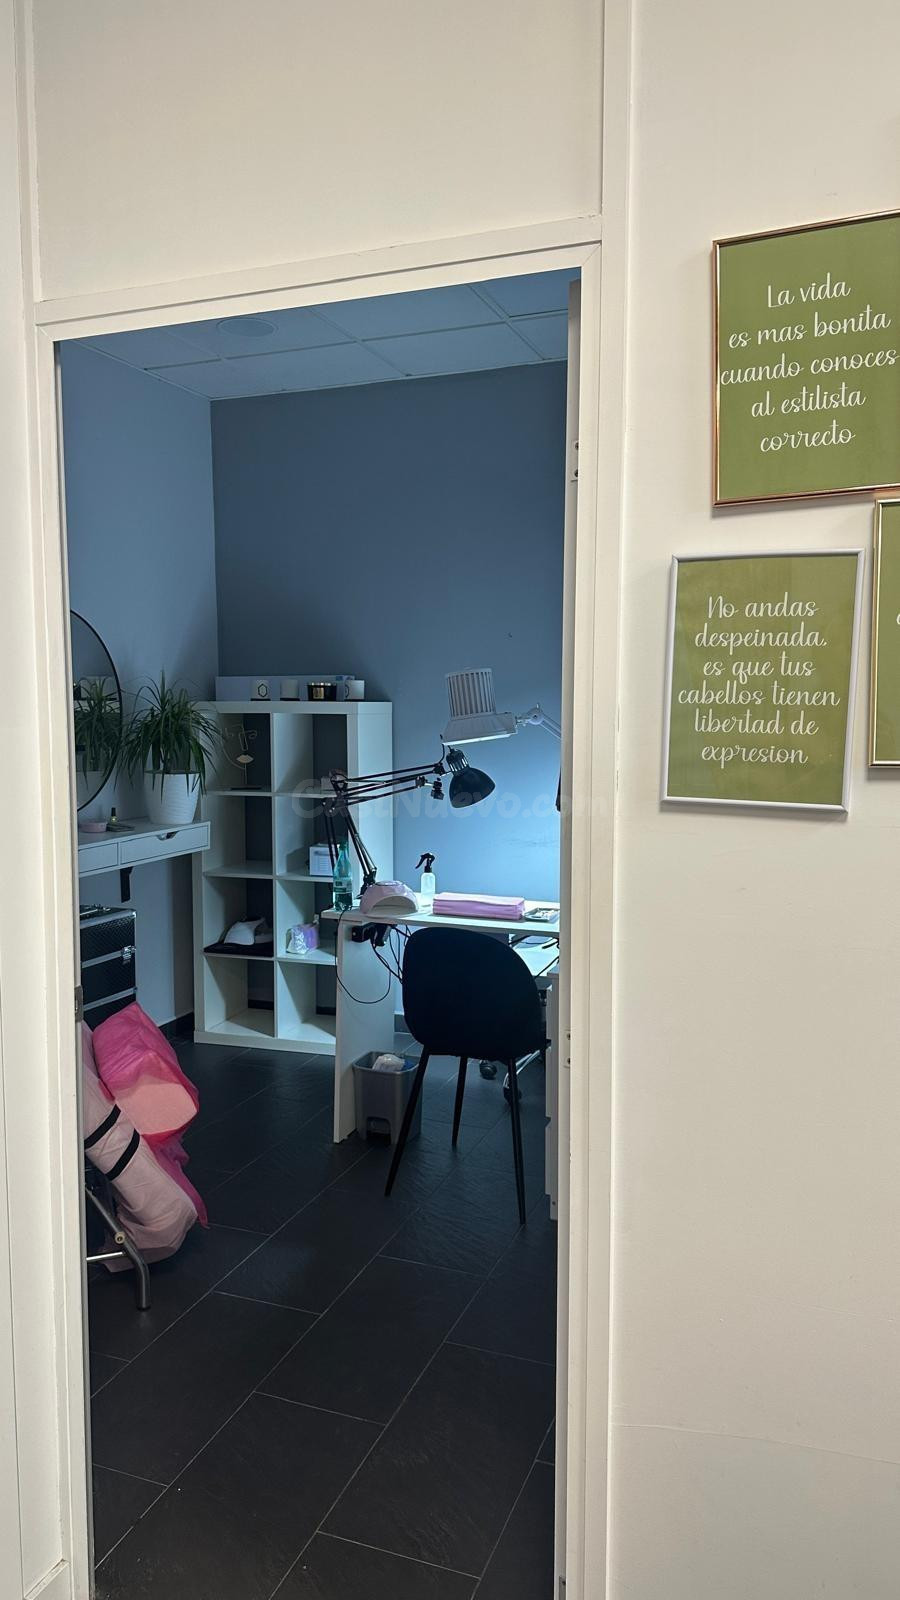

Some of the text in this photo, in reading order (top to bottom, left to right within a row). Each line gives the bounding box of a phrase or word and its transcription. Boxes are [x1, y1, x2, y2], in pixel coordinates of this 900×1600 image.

[767, 272, 852, 308] La vida
[728, 304, 892, 349] es mas bonita
[720, 349, 900, 386] cuando conoces
[751, 381, 866, 418] al estilista
[760, 419, 856, 452] correcto
[708, 591, 819, 619] No andas
[703, 650, 815, 686] es que tus
[677, 679, 841, 706] cabellos tienen
[694, 707, 819, 736] libertad de
[701, 744, 809, 769] expresion
